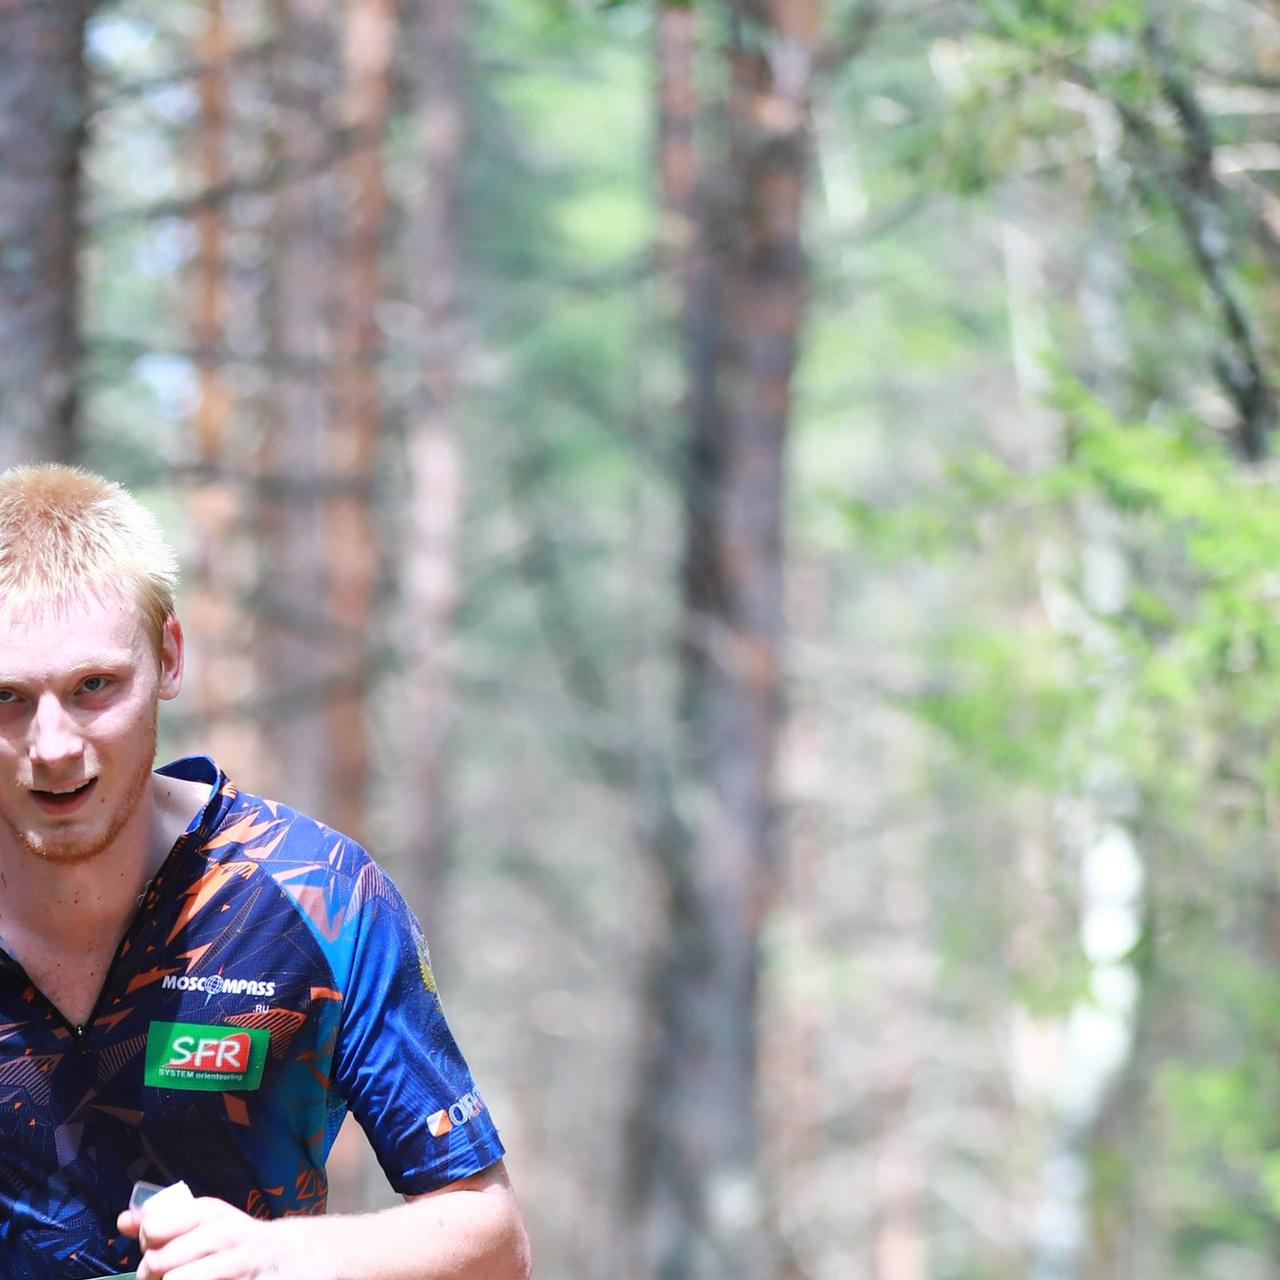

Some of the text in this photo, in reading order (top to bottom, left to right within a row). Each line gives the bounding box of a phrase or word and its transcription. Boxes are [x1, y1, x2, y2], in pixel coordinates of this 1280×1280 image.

[170, 1036, 241, 1068] SFR
[158, 1068, 243, 1082] SYSTEM orienteering
